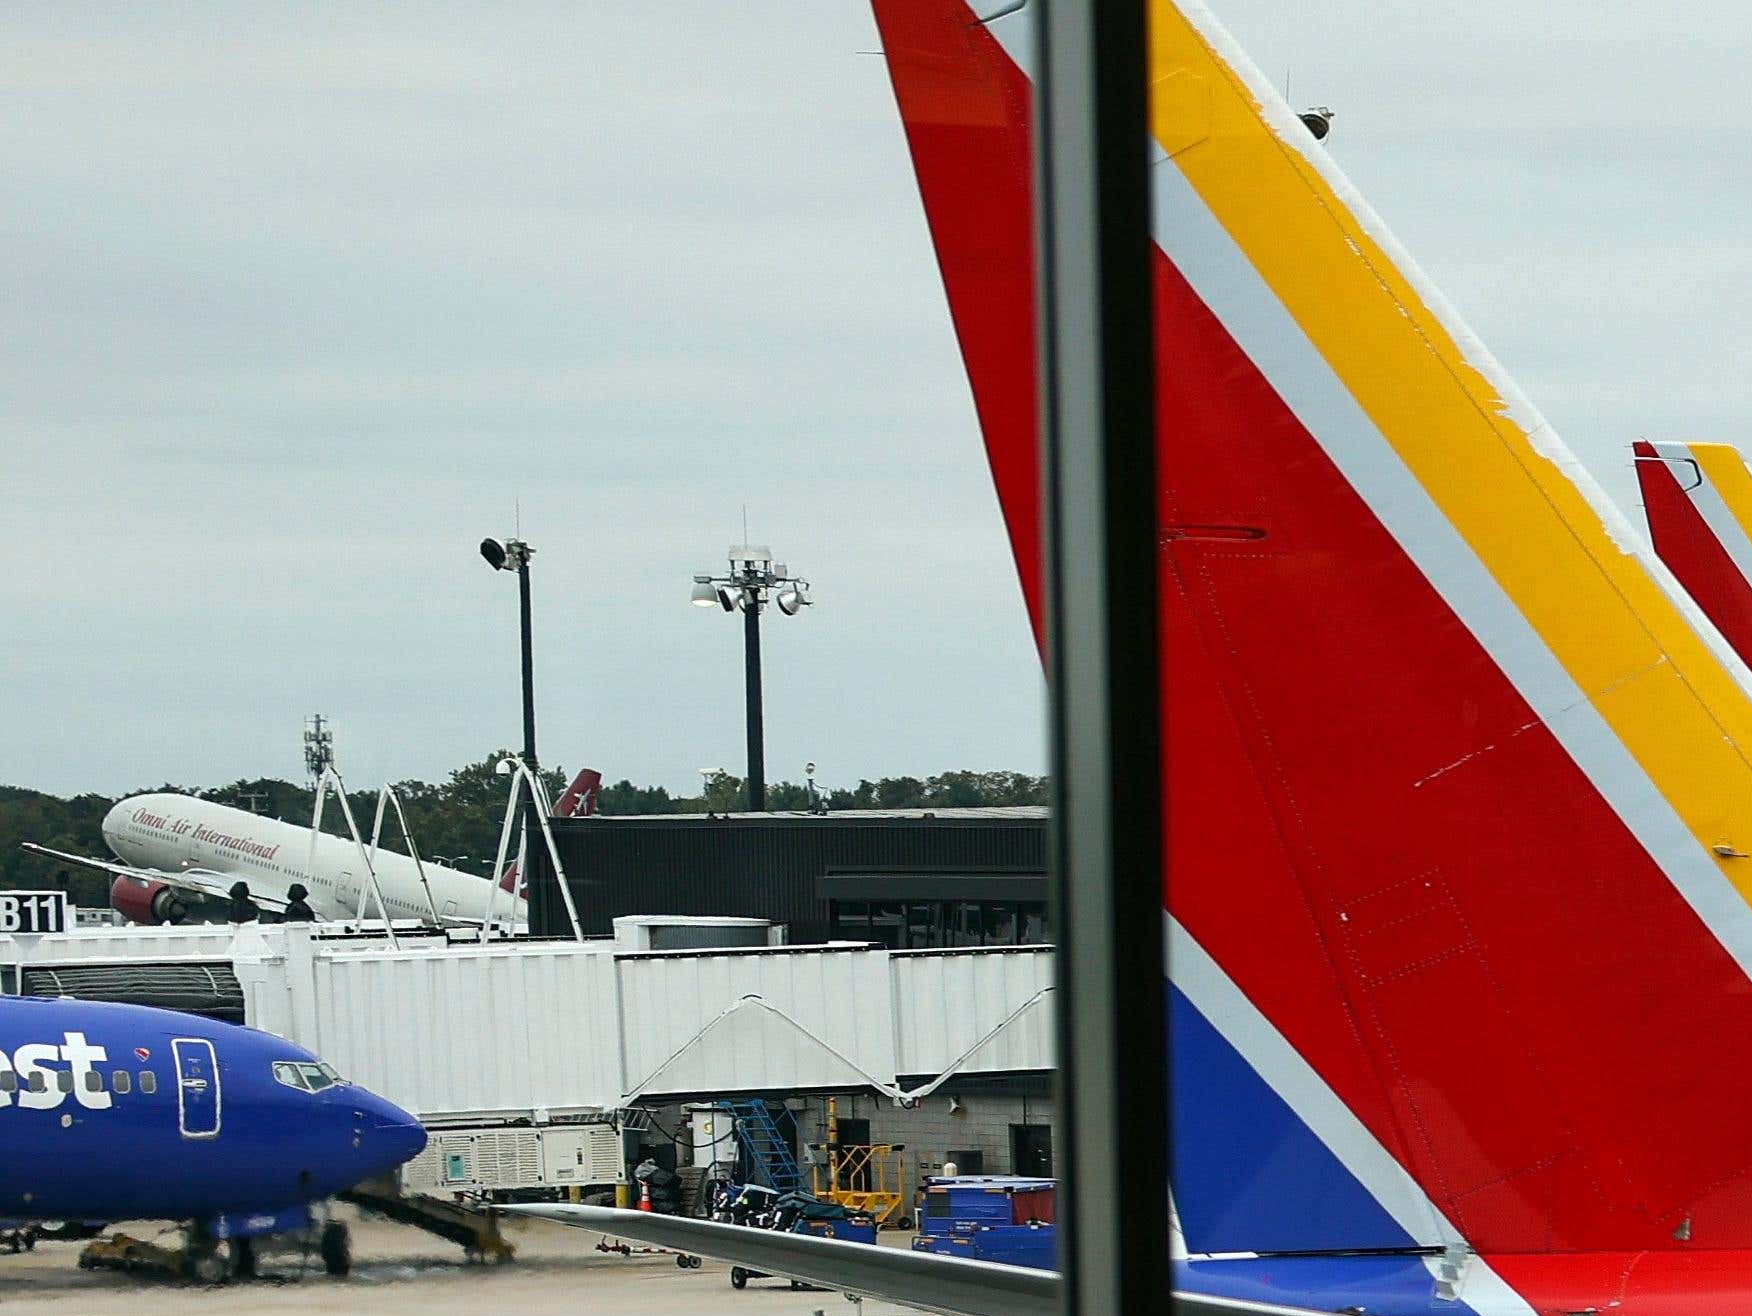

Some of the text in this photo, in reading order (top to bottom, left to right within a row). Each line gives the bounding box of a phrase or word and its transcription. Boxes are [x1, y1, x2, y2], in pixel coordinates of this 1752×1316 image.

[132, 807, 280, 861] Omni Air International
[0, 895, 57, 932] B11
[0, 1031, 112, 1109] st
